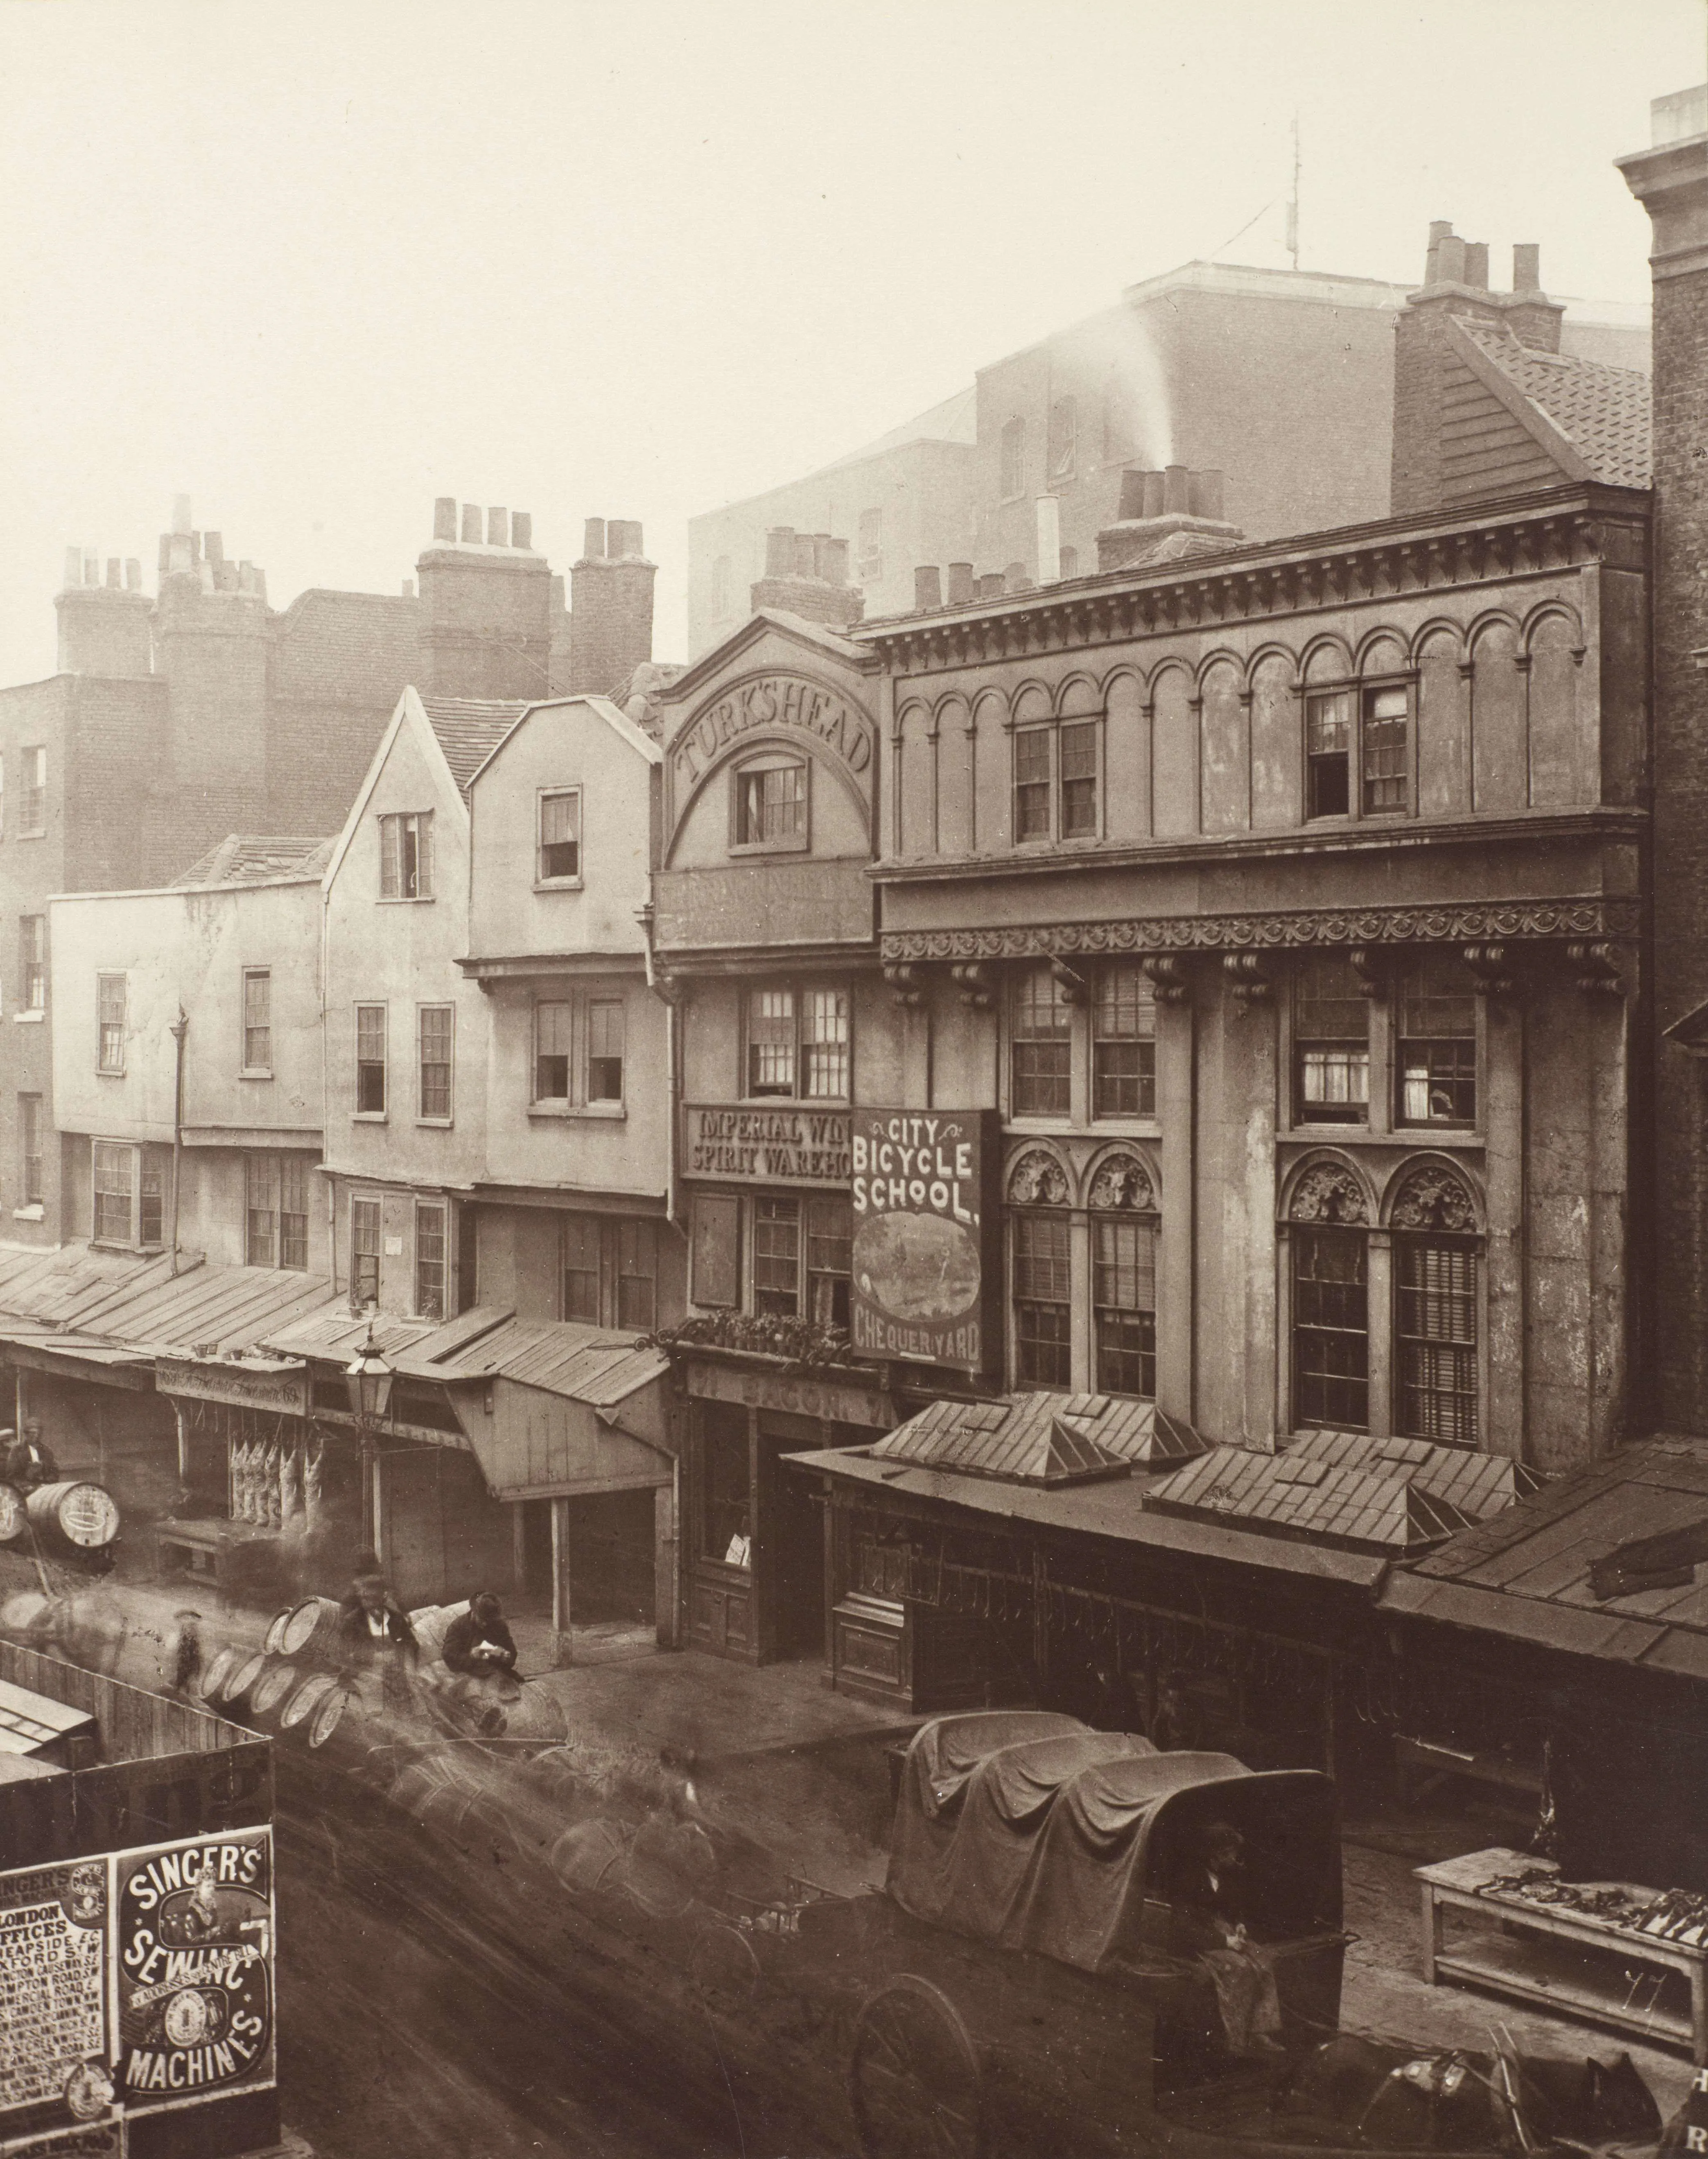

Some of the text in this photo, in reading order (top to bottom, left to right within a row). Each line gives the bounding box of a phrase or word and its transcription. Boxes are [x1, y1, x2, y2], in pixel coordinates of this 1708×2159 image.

[677, 681, 871, 783] TURK'S HEAD
[698, 1112, 804, 1142] IMPERIAL
[888, 1118, 939, 1147] CITY
[693, 1146, 757, 1174] SPIRIT
[853, 1135, 971, 1180] BICYCLE
[934, 1320, 979, 1361] YARD
[129, 1845, 262, 1910] SINGER'S
[124, 1929, 258, 1990] SEWING
[126, 2010, 262, 2089] MACHINES
